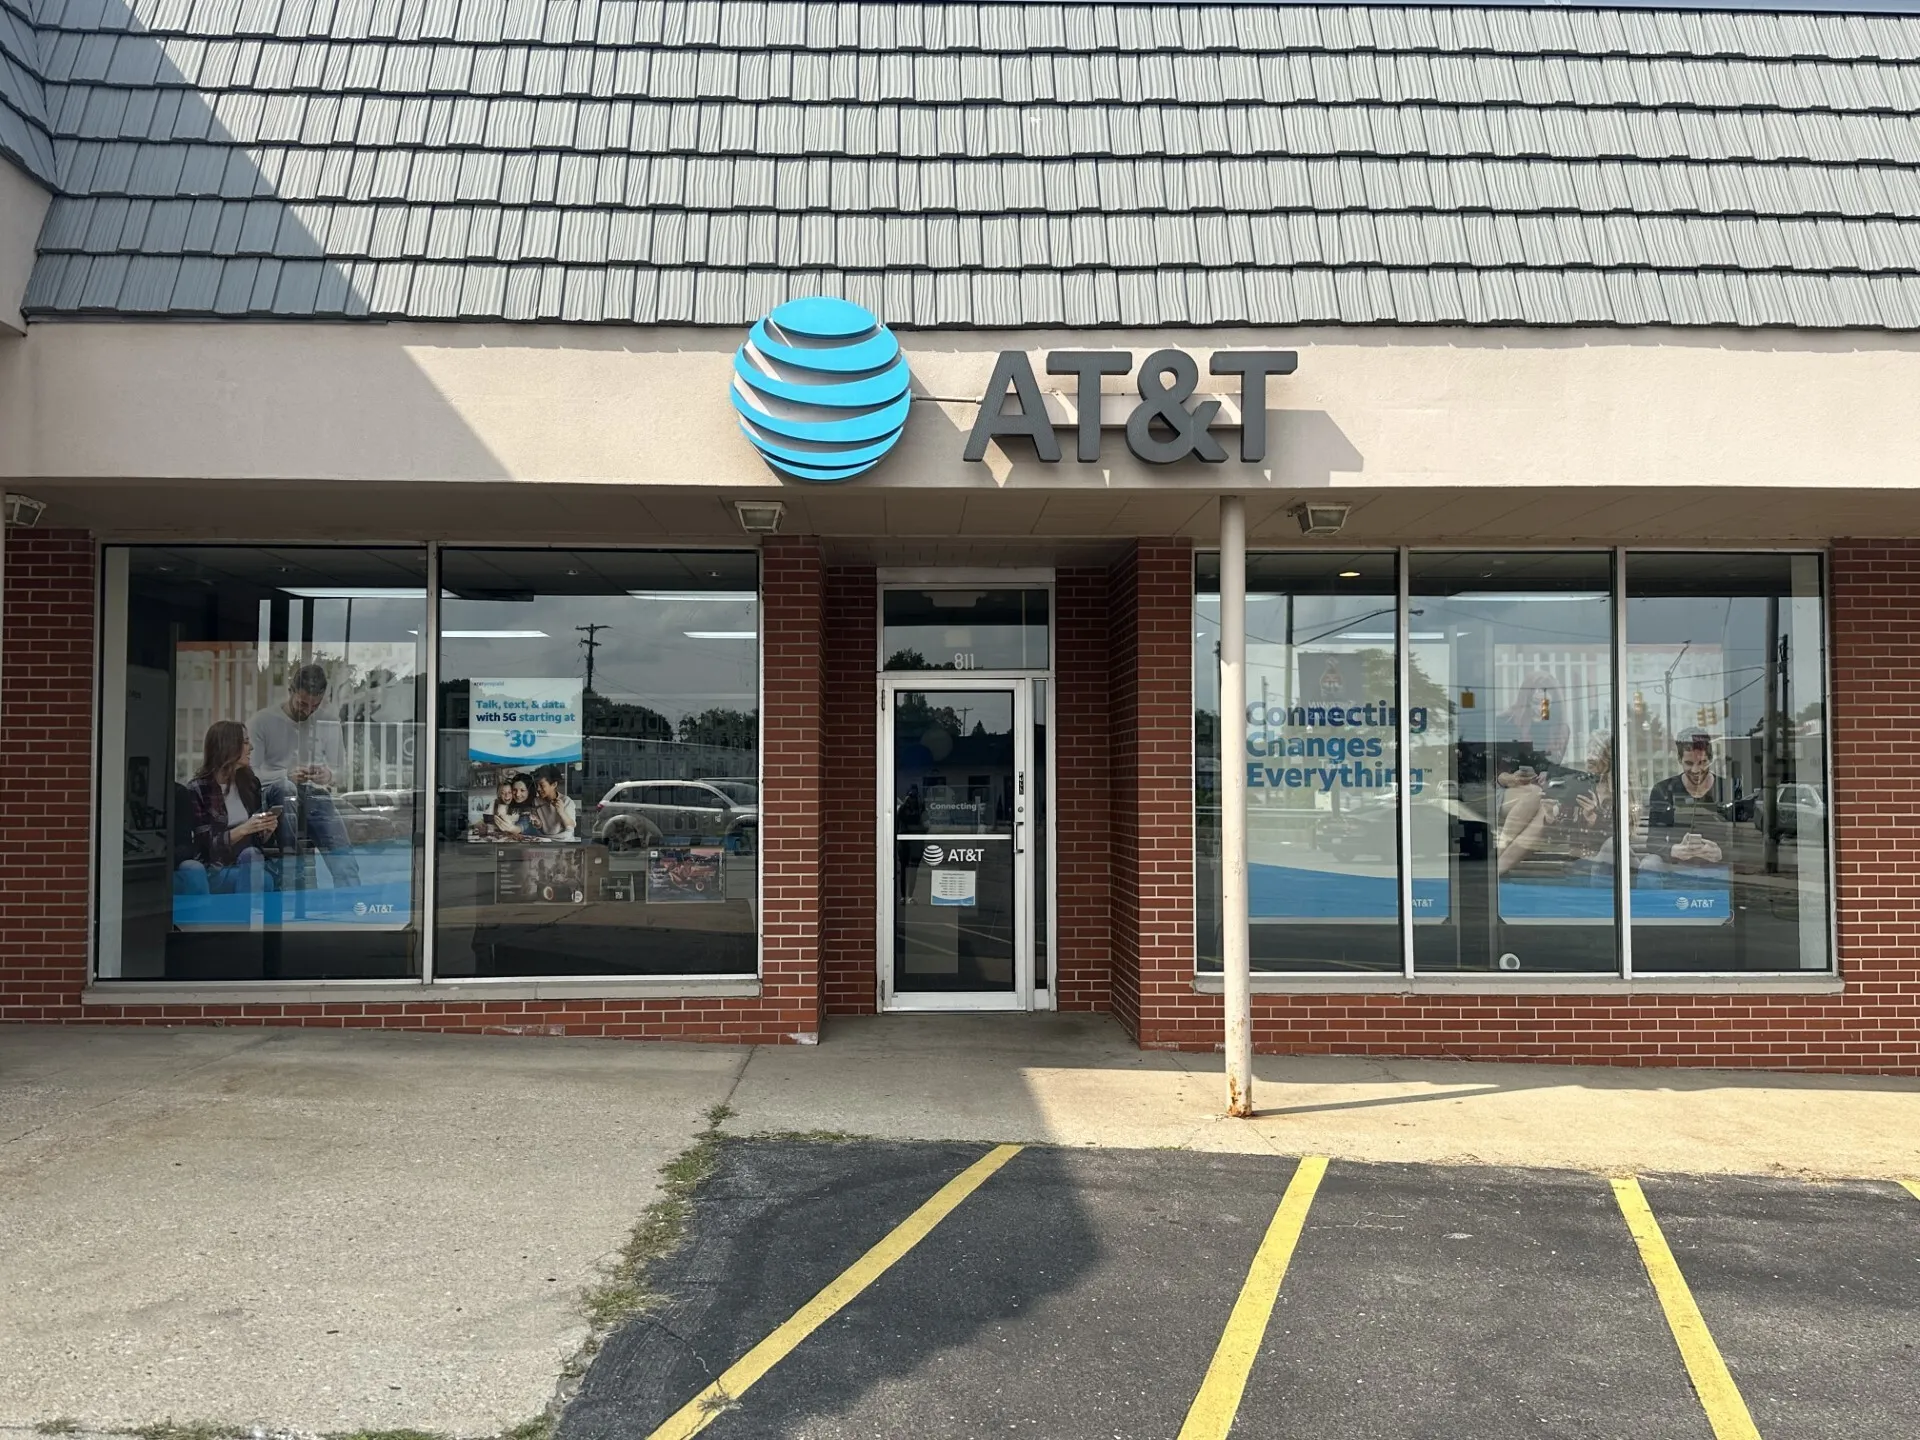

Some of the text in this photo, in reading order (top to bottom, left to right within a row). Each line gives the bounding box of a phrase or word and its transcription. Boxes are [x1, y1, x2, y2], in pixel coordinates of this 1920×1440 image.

[963, 348, 1298, 465] AT&T
[954, 652, 974, 670] 811
[476, 700, 565, 710] Talk, text, & data
[476, 712, 575, 724] with 5G starting at
[1246, 731, 1382, 764] Changes
[930, 802, 977, 811] Connecting
[947, 848, 985, 862] AT&T
[368, 904, 394, 913] AT&T
[1690, 899, 1714, 908] AT&T
